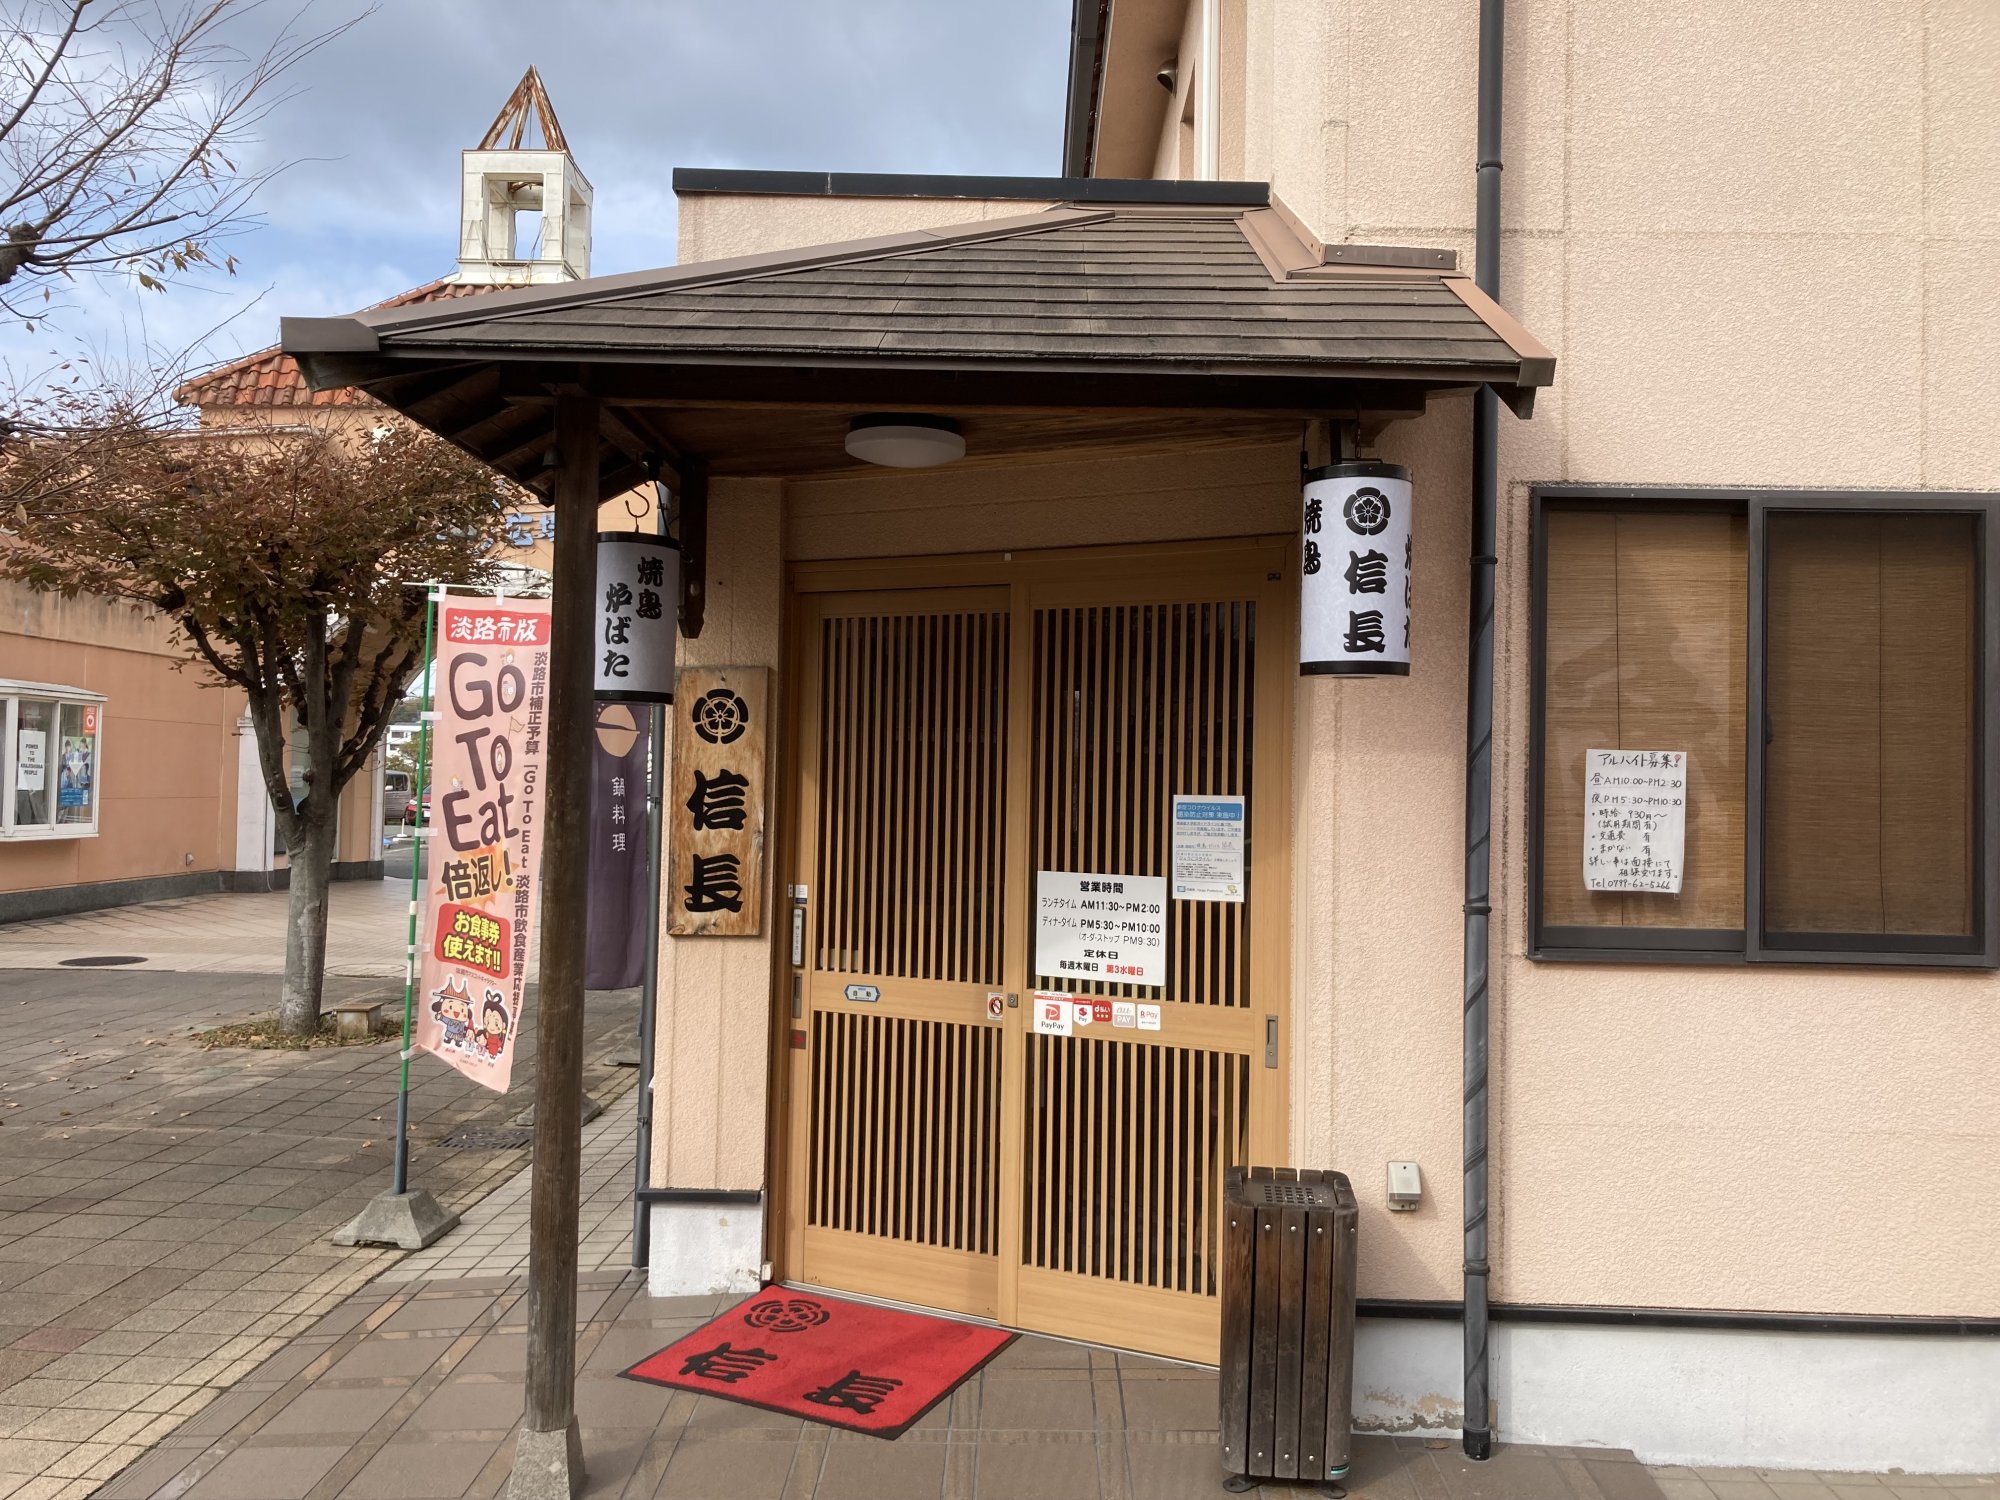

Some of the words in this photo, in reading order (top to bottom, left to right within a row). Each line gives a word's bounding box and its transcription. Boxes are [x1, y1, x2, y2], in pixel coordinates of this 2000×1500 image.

[636, 556, 665, 622] 焼鳥
[1343, 548, 1389, 654] 信長
[450, 615, 539, 642] 淡路市版
[603, 582, 634, 678] 炉ばた
[449, 652, 526, 721] Go
[525, 651, 549, 756] 淡路市補正予算
[455, 726, 513, 792] To
[442, 782, 520, 851] Eat
[522, 800, 535, 826] To
[612, 776, 626, 852] 鍋料理
[520, 829, 532, 870] Eat
[684, 768, 751, 914] 信長
[441, 850, 514, 902] 倍返し!
[1080, 881, 1124, 894] 営業時間
[1591, 878, 1605, 889] Tel
[454, 910, 501, 946] お食事券
[1041, 897, 1077, 910] ランチタイム
[1059, 960, 1099, 972] 毎週木曜日
[1106, 964, 1144, 976] 第3水曜日
[1083, 949, 1119, 960] 定休日
[1041, 1020, 1065, 1031] PayPay
[678, 1341, 904, 1415] 信長
